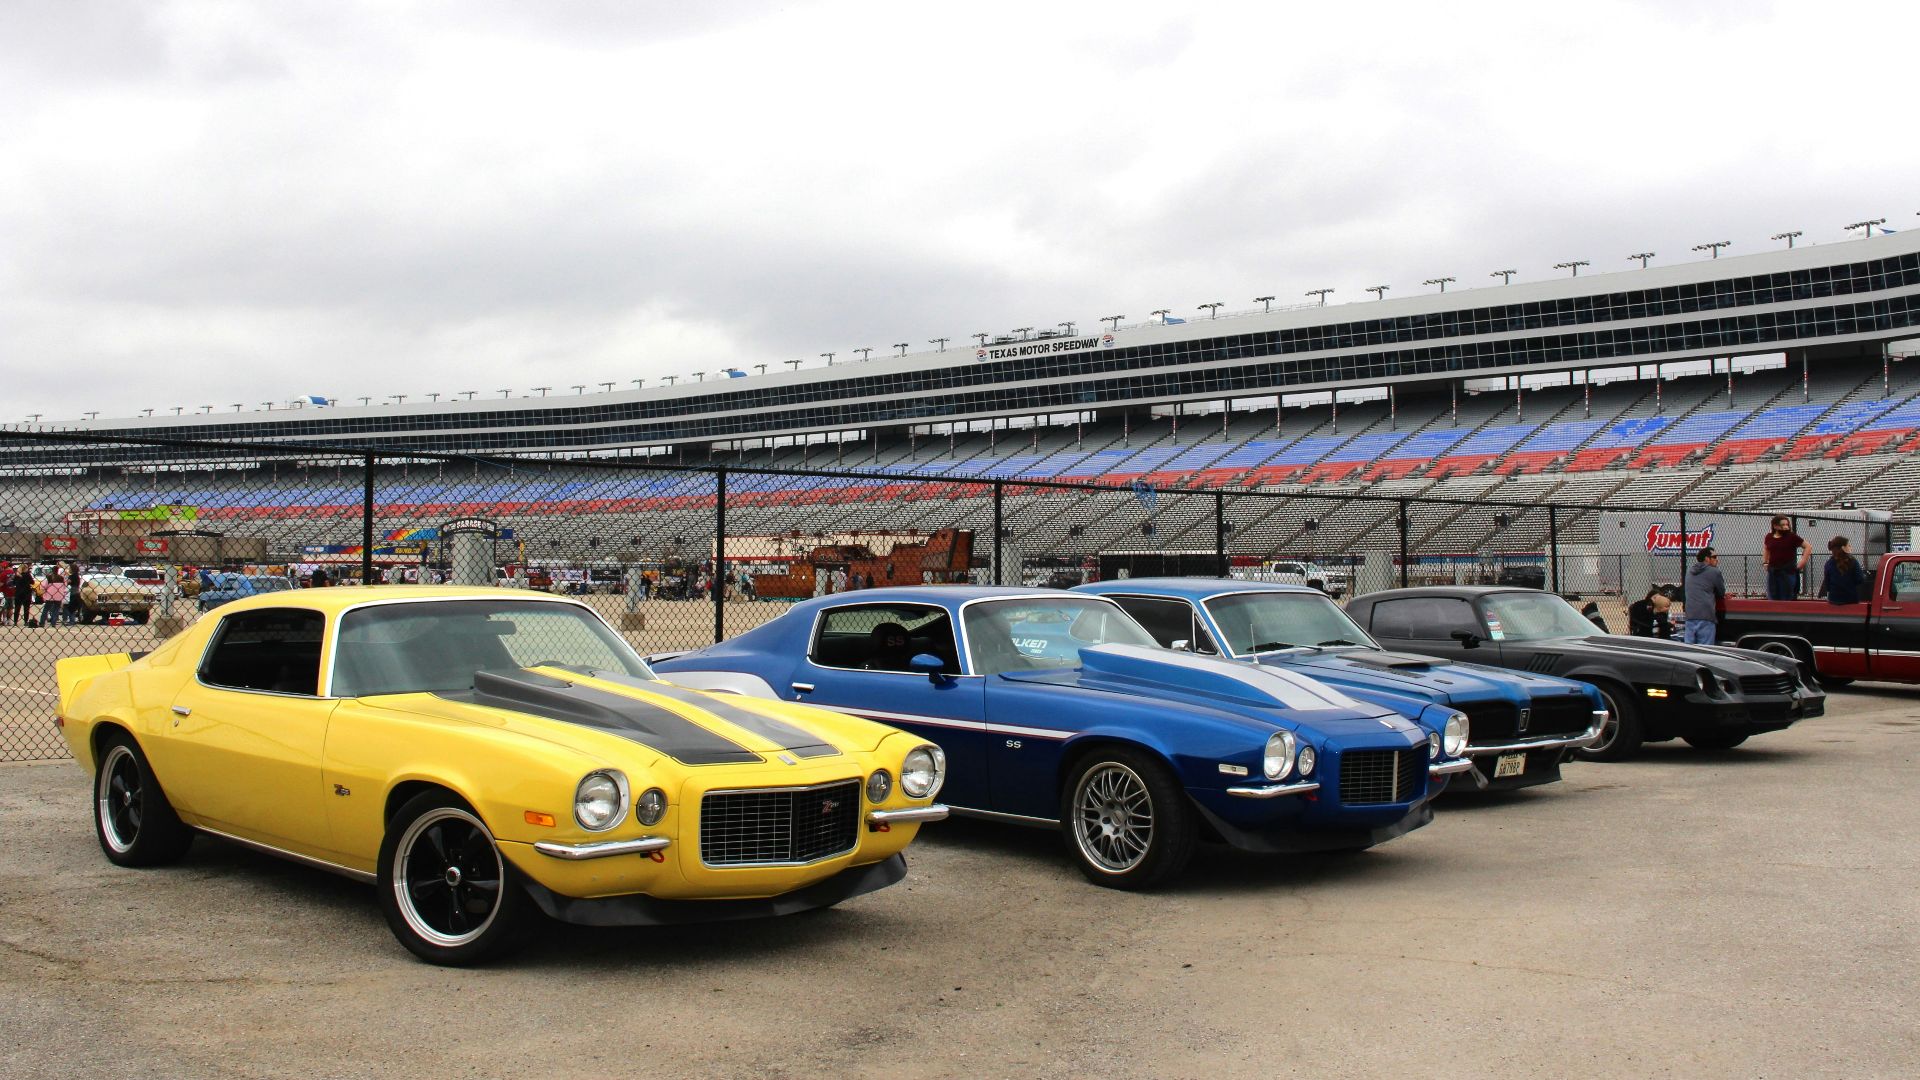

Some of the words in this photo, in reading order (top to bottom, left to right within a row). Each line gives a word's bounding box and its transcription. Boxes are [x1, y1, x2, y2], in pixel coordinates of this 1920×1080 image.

[989, 347, 1018, 360] TEXAS
[1020, 344, 1050, 356] MOTOR
[1052, 337, 1100, 352] SPEEDWAY
[1006, 739, 1022, 749] SS
